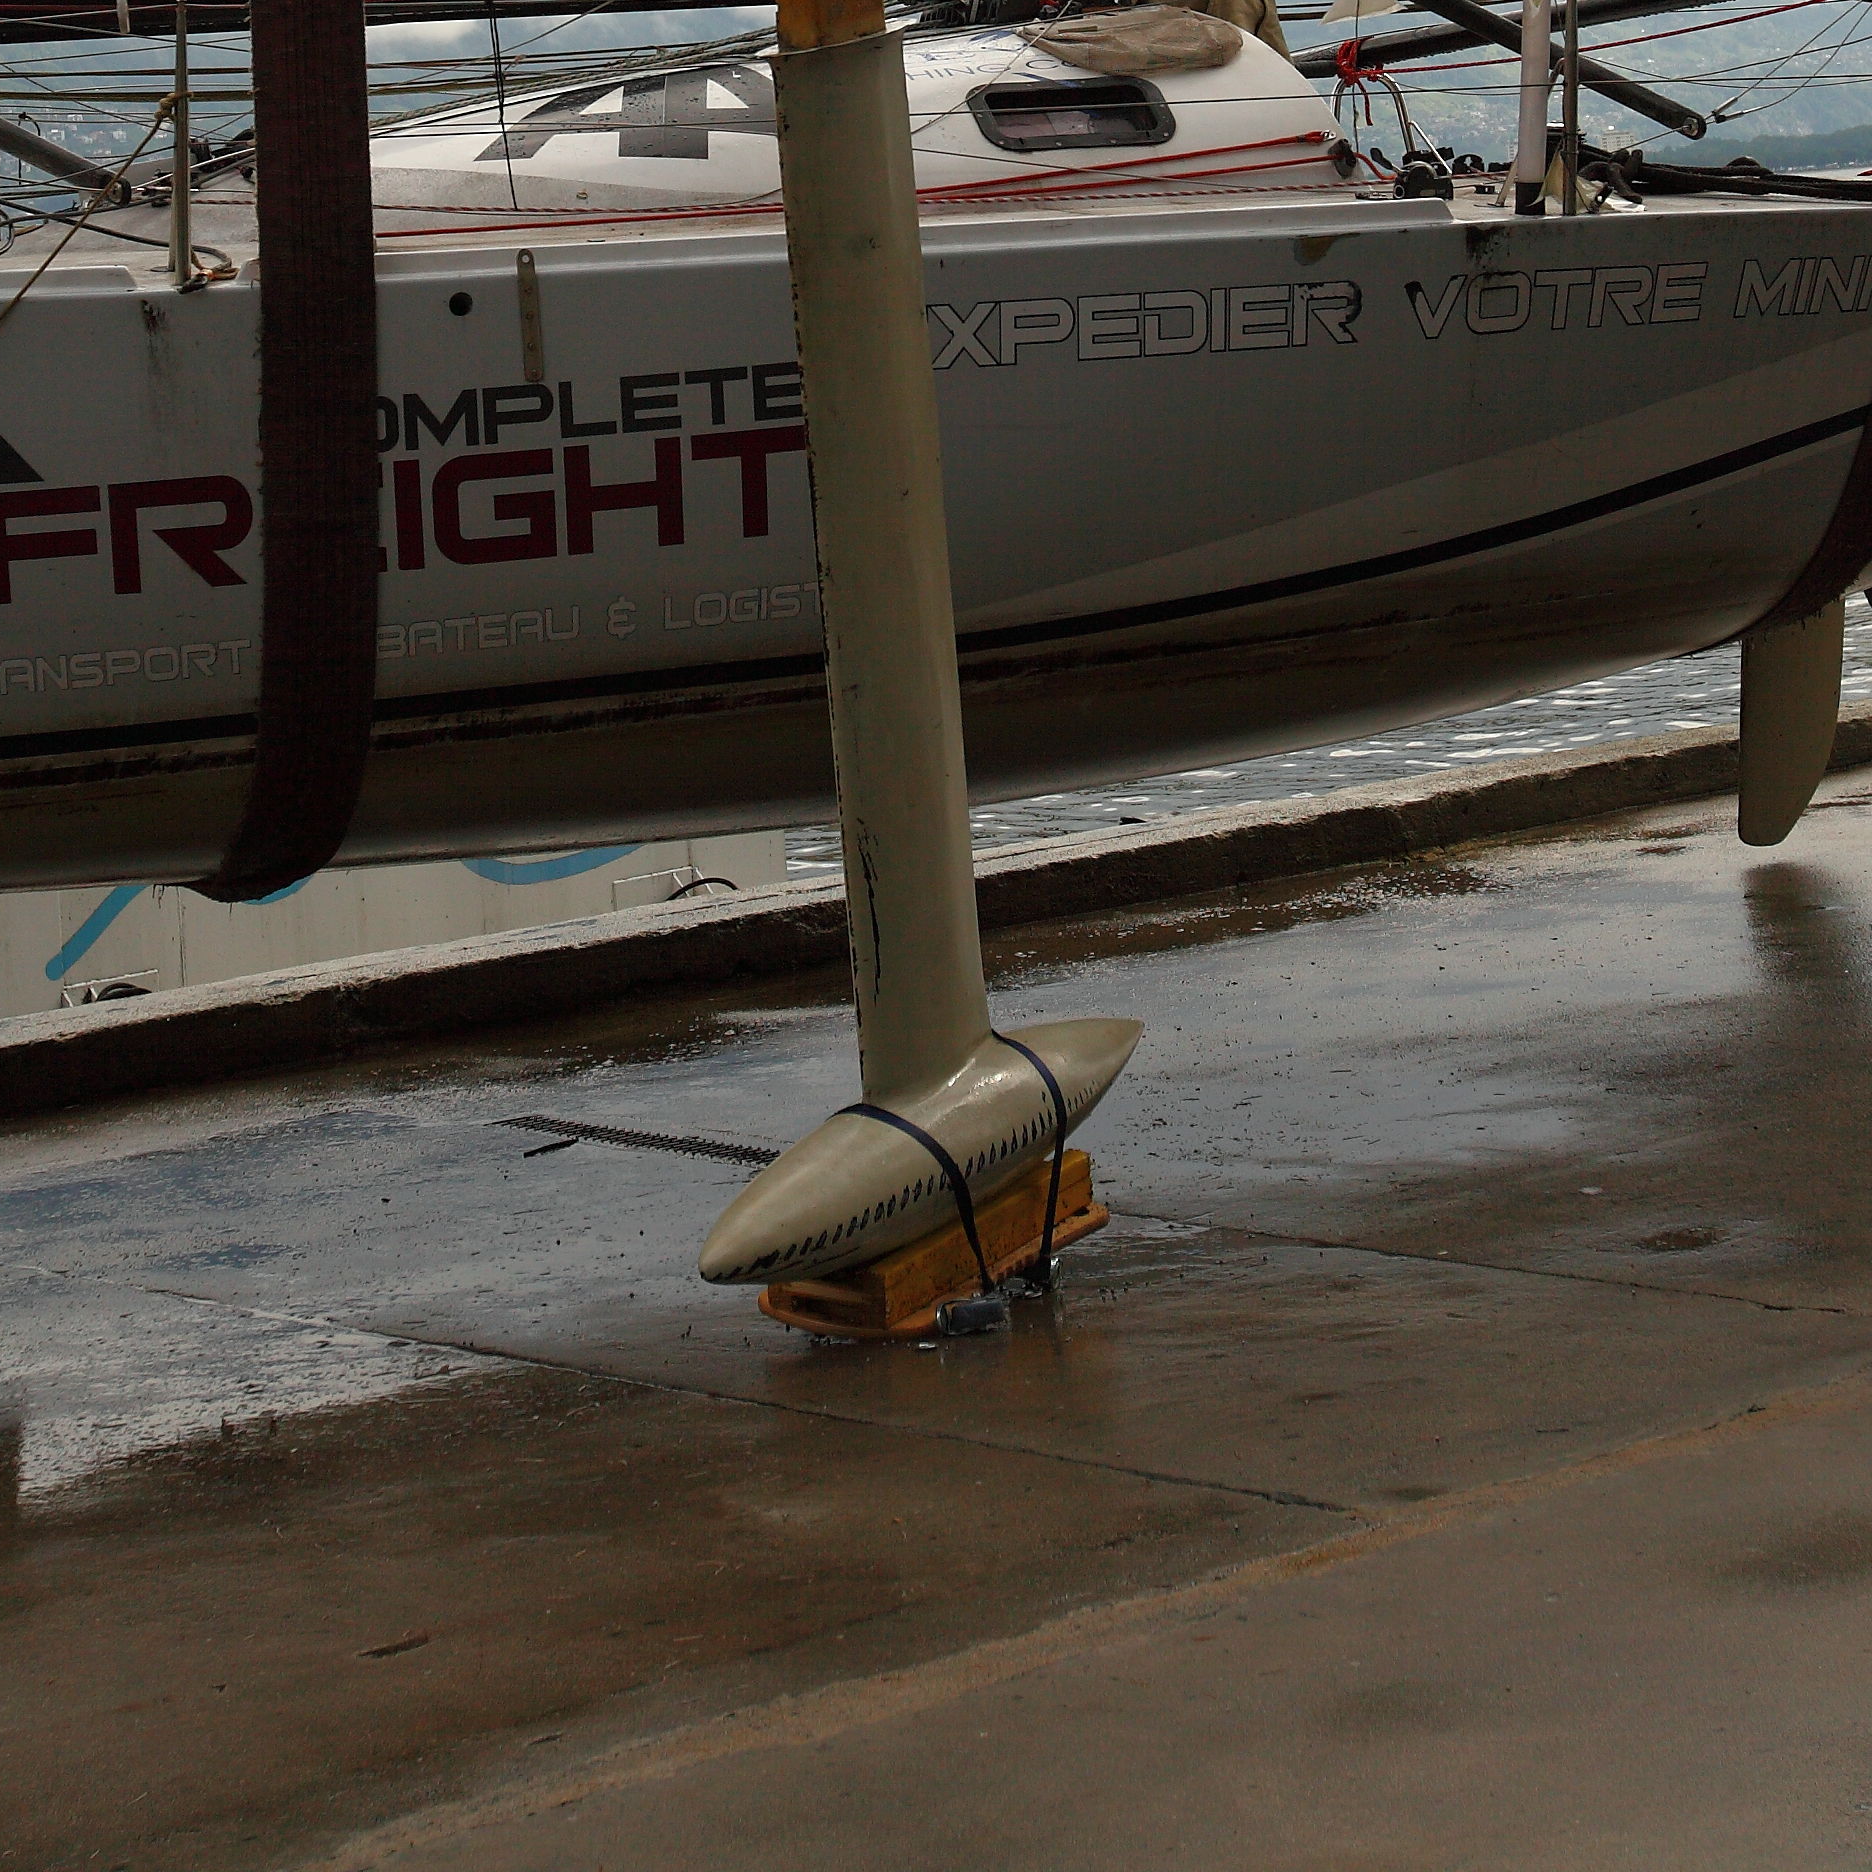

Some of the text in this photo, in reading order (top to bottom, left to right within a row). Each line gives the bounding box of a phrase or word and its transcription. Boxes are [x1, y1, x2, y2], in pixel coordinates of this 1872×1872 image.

[1404, 261, 1709, 341] VOTRE
[375, 604, 580, 659] BATEAU
[606, 595, 638, 640] &
